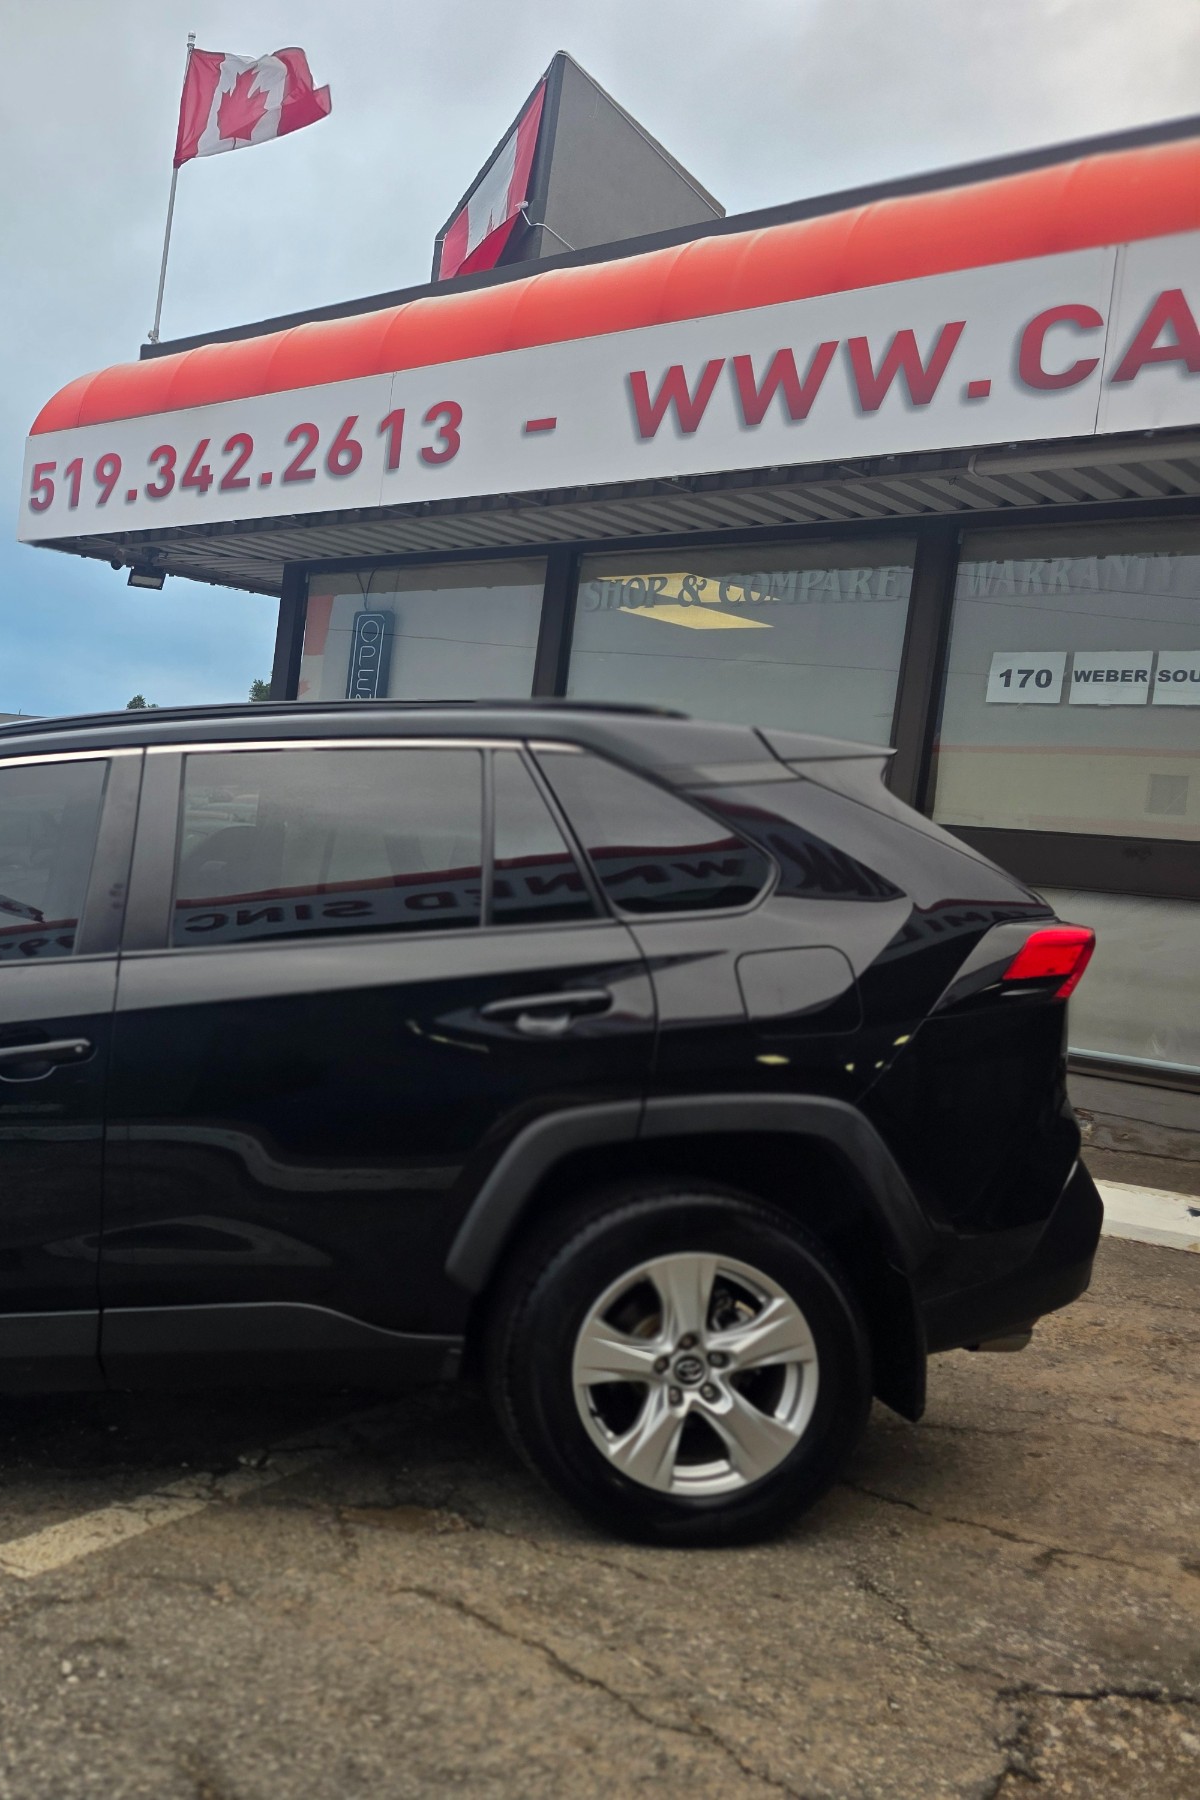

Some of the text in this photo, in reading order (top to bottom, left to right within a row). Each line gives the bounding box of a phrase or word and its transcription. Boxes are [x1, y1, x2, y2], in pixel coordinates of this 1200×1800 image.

[29, 400, 464, 512] 519.342.2613
[581, 566, 906, 611] SHOP & COMPARE
[355, 620, 380, 699] OPE
[999, 669, 1053, 688] 170
[1074, 669, 1148, 683] WEBER
